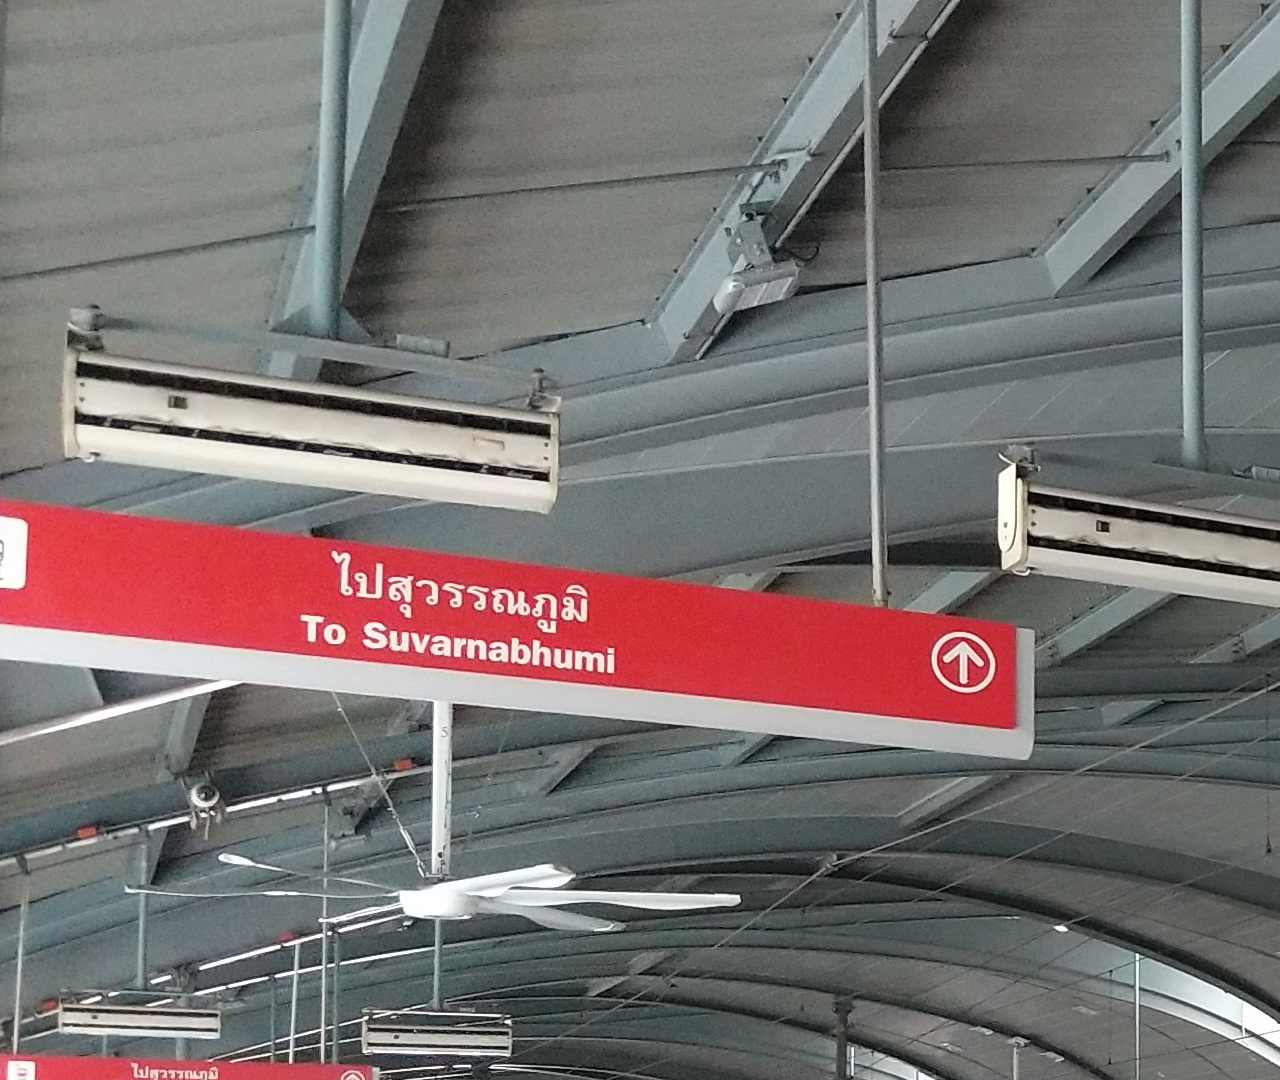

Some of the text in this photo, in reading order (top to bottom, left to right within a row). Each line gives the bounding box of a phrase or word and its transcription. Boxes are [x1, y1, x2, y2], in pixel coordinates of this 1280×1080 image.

[331, 550, 588, 634] ไปสุวรรณภูมิ
[301, 613, 615, 674] To Suvarnabhumi
